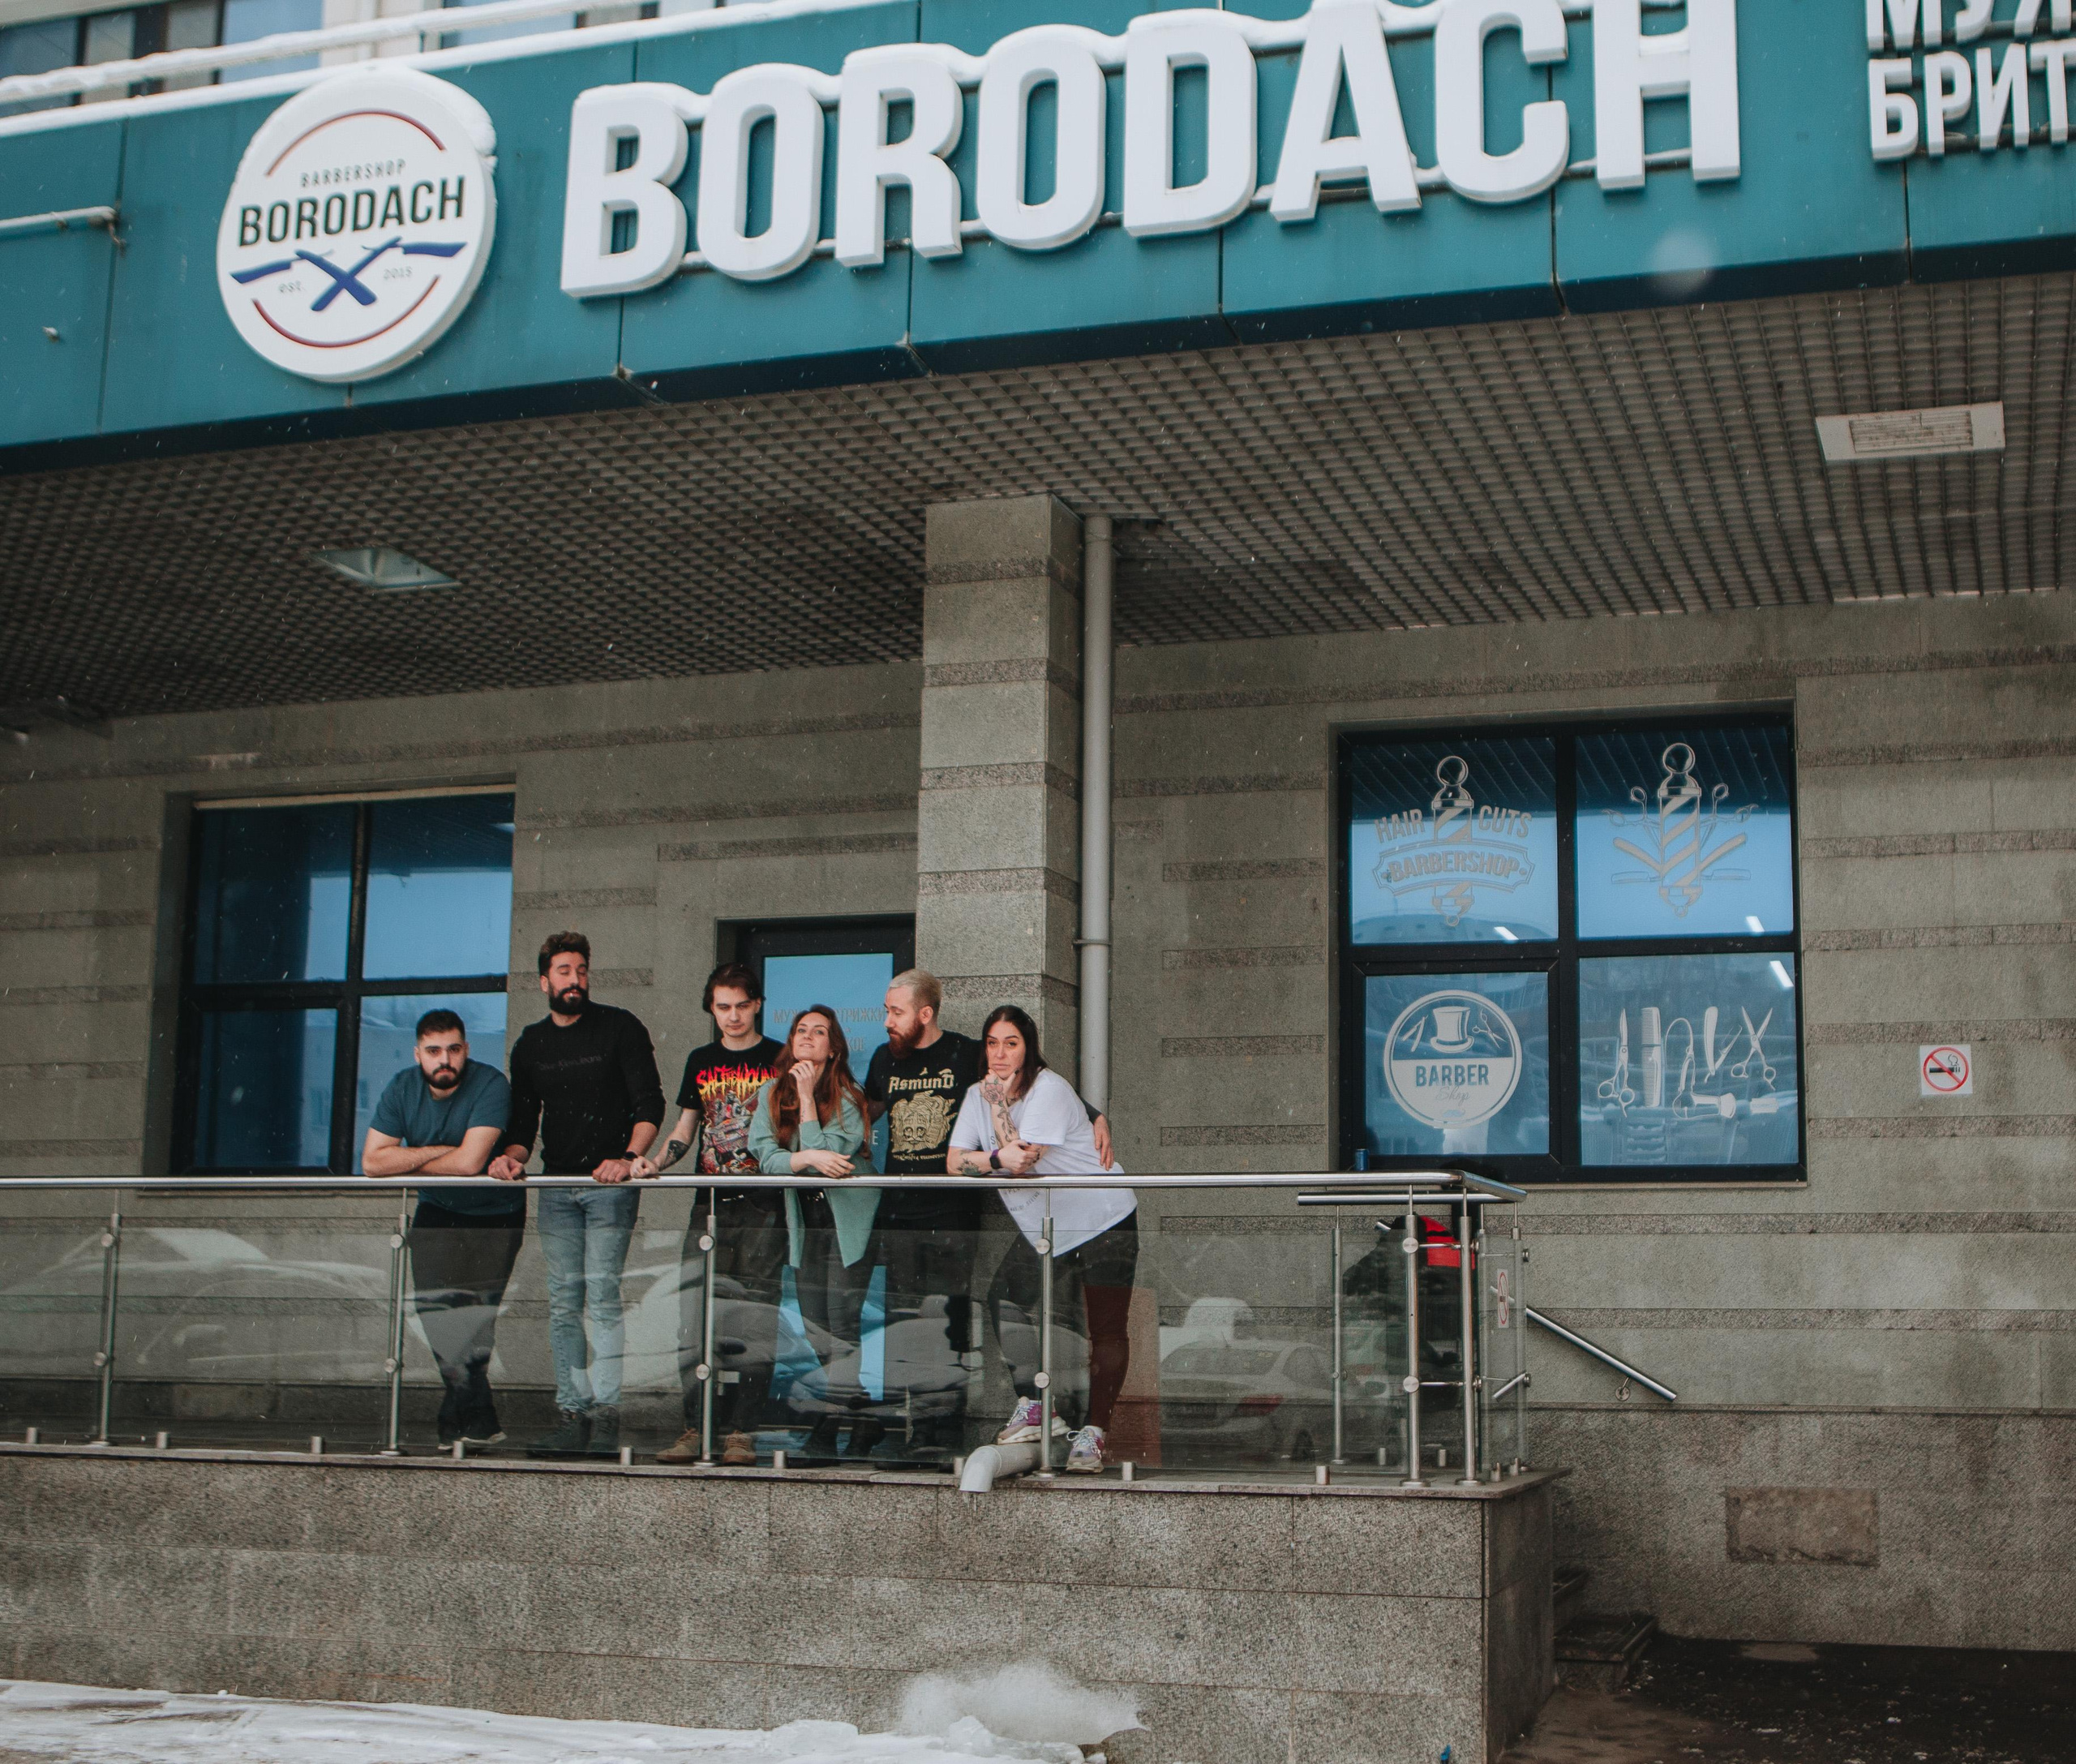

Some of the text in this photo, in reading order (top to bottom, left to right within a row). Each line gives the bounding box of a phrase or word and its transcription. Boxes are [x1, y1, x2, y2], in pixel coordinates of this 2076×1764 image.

[1868, 37, 2076, 160] БРИТ
[560, 0, 1740, 297] BORODACH
[300, 159, 406, 188] BARBERSHOP
[238, 175, 467, 247] BORODACH
[1375, 805, 1533, 844] HAIR CUTS
[1388, 850, 1521, 882] BARBERSHOP
[834, 1007, 886, 1023] ТРИЖКИ
[1416, 1064, 1490, 1087] BARBER
